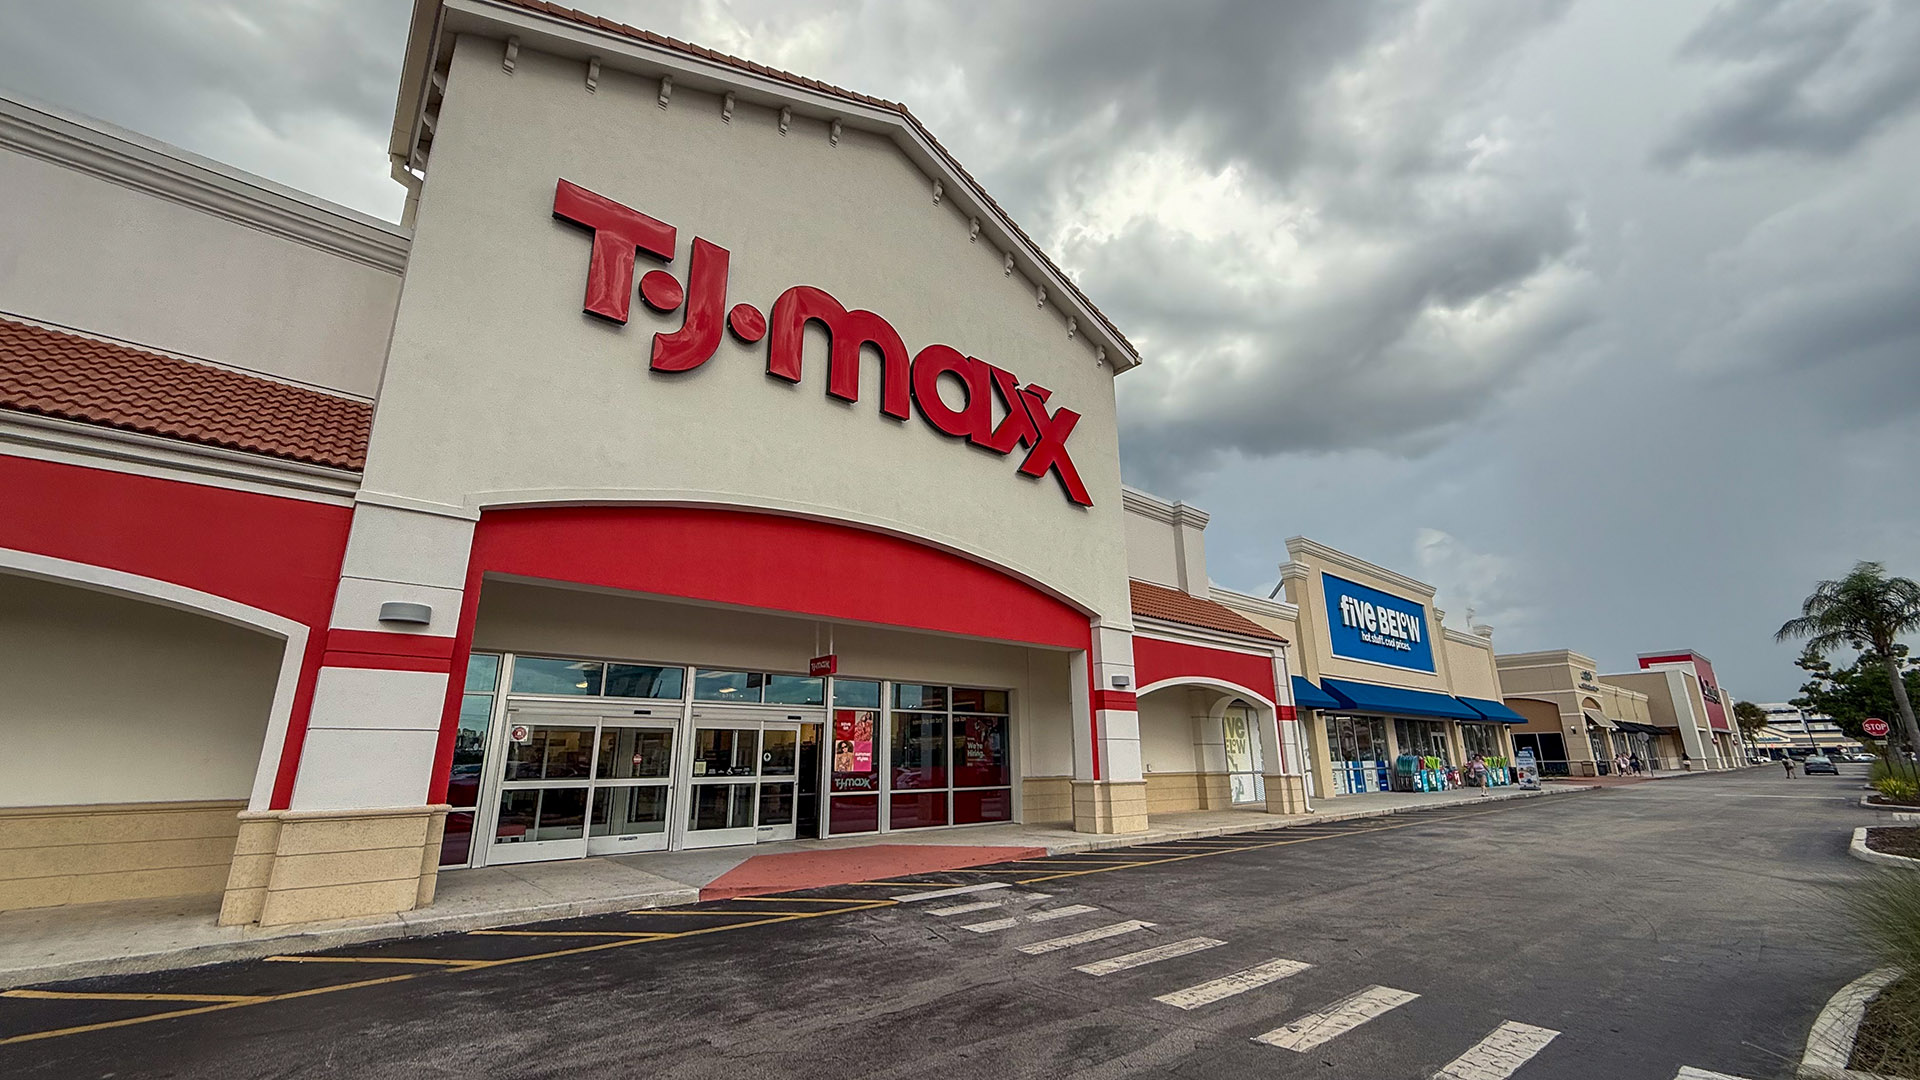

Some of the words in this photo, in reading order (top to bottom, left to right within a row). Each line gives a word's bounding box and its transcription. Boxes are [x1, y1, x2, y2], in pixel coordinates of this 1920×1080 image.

[1340, 594, 1377, 632] five
[1376, 605, 1420, 643] BELOW
[1361, 630, 1371, 642] hot
[1385, 638, 1395, 648] cool
[1865, 723, 1886, 731] STOP
